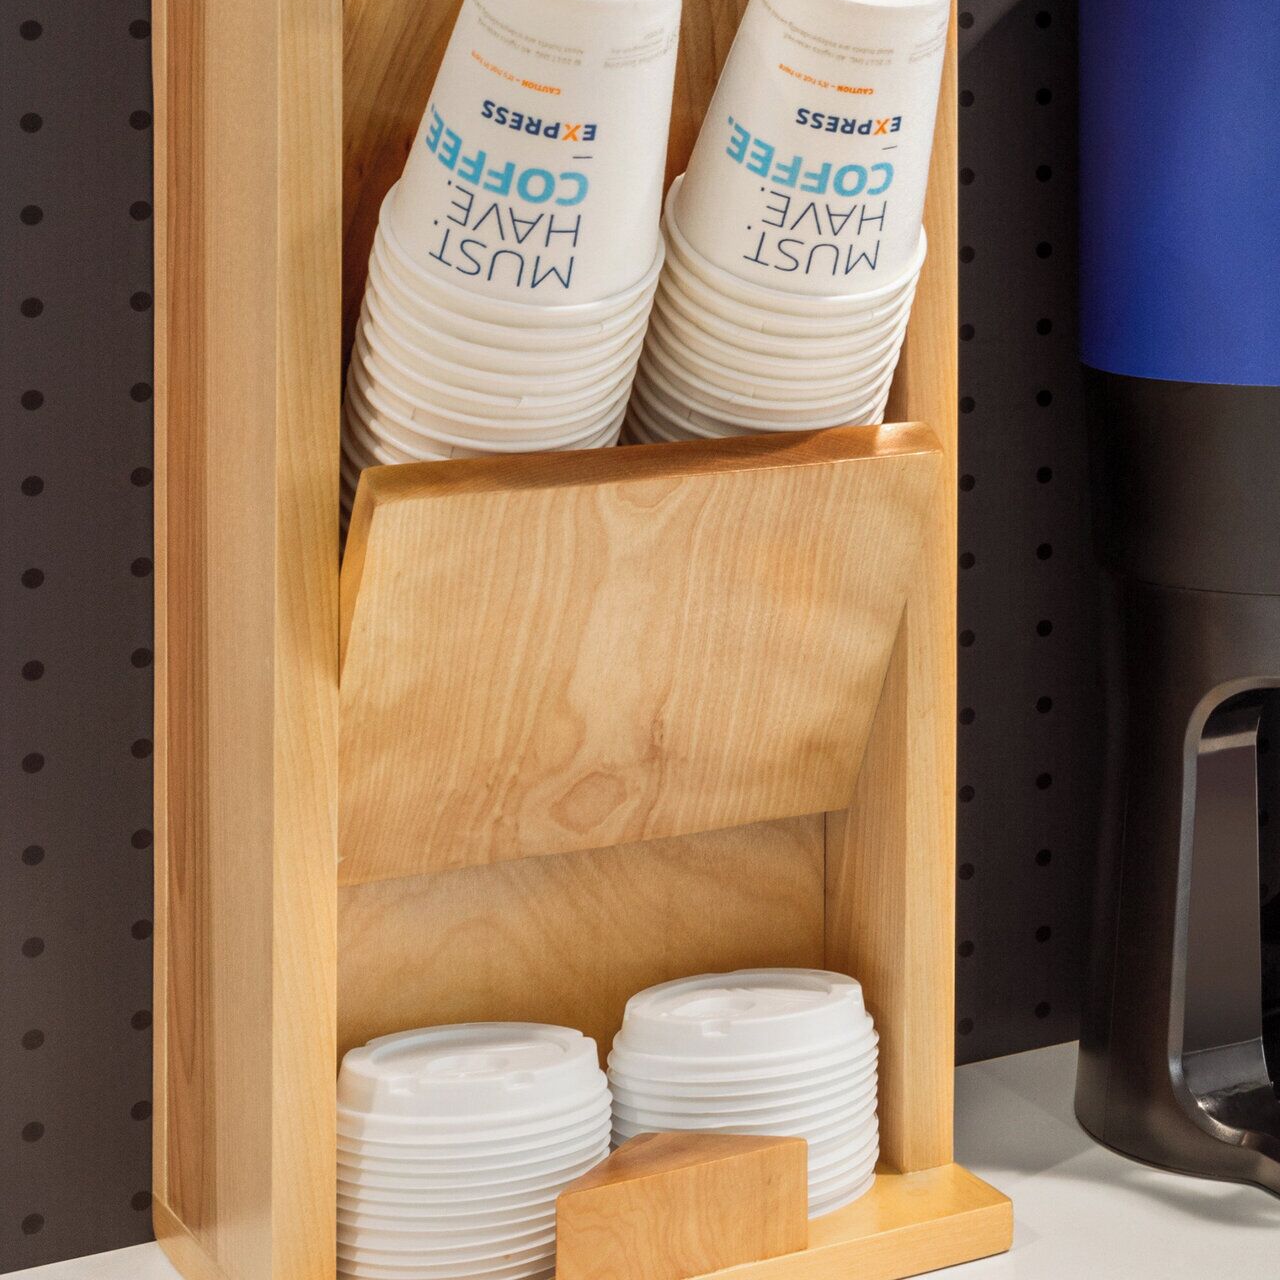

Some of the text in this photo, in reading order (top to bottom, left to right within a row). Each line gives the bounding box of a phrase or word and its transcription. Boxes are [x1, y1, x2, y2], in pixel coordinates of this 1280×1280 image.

[520, 79, 562, 96] CAUTION
[837, 85, 874, 96] CAUTION
[480, 100, 598, 142] EXPRESS
[796, 108, 902, 136] EXPRESS
[725, 116, 895, 197] COFFEE.
[446, 180, 582, 248] HAVE.
[760, 186, 888, 236] HAVE.
[428, 219, 576, 289] MUST.
[742, 225, 880, 276] MUST.
